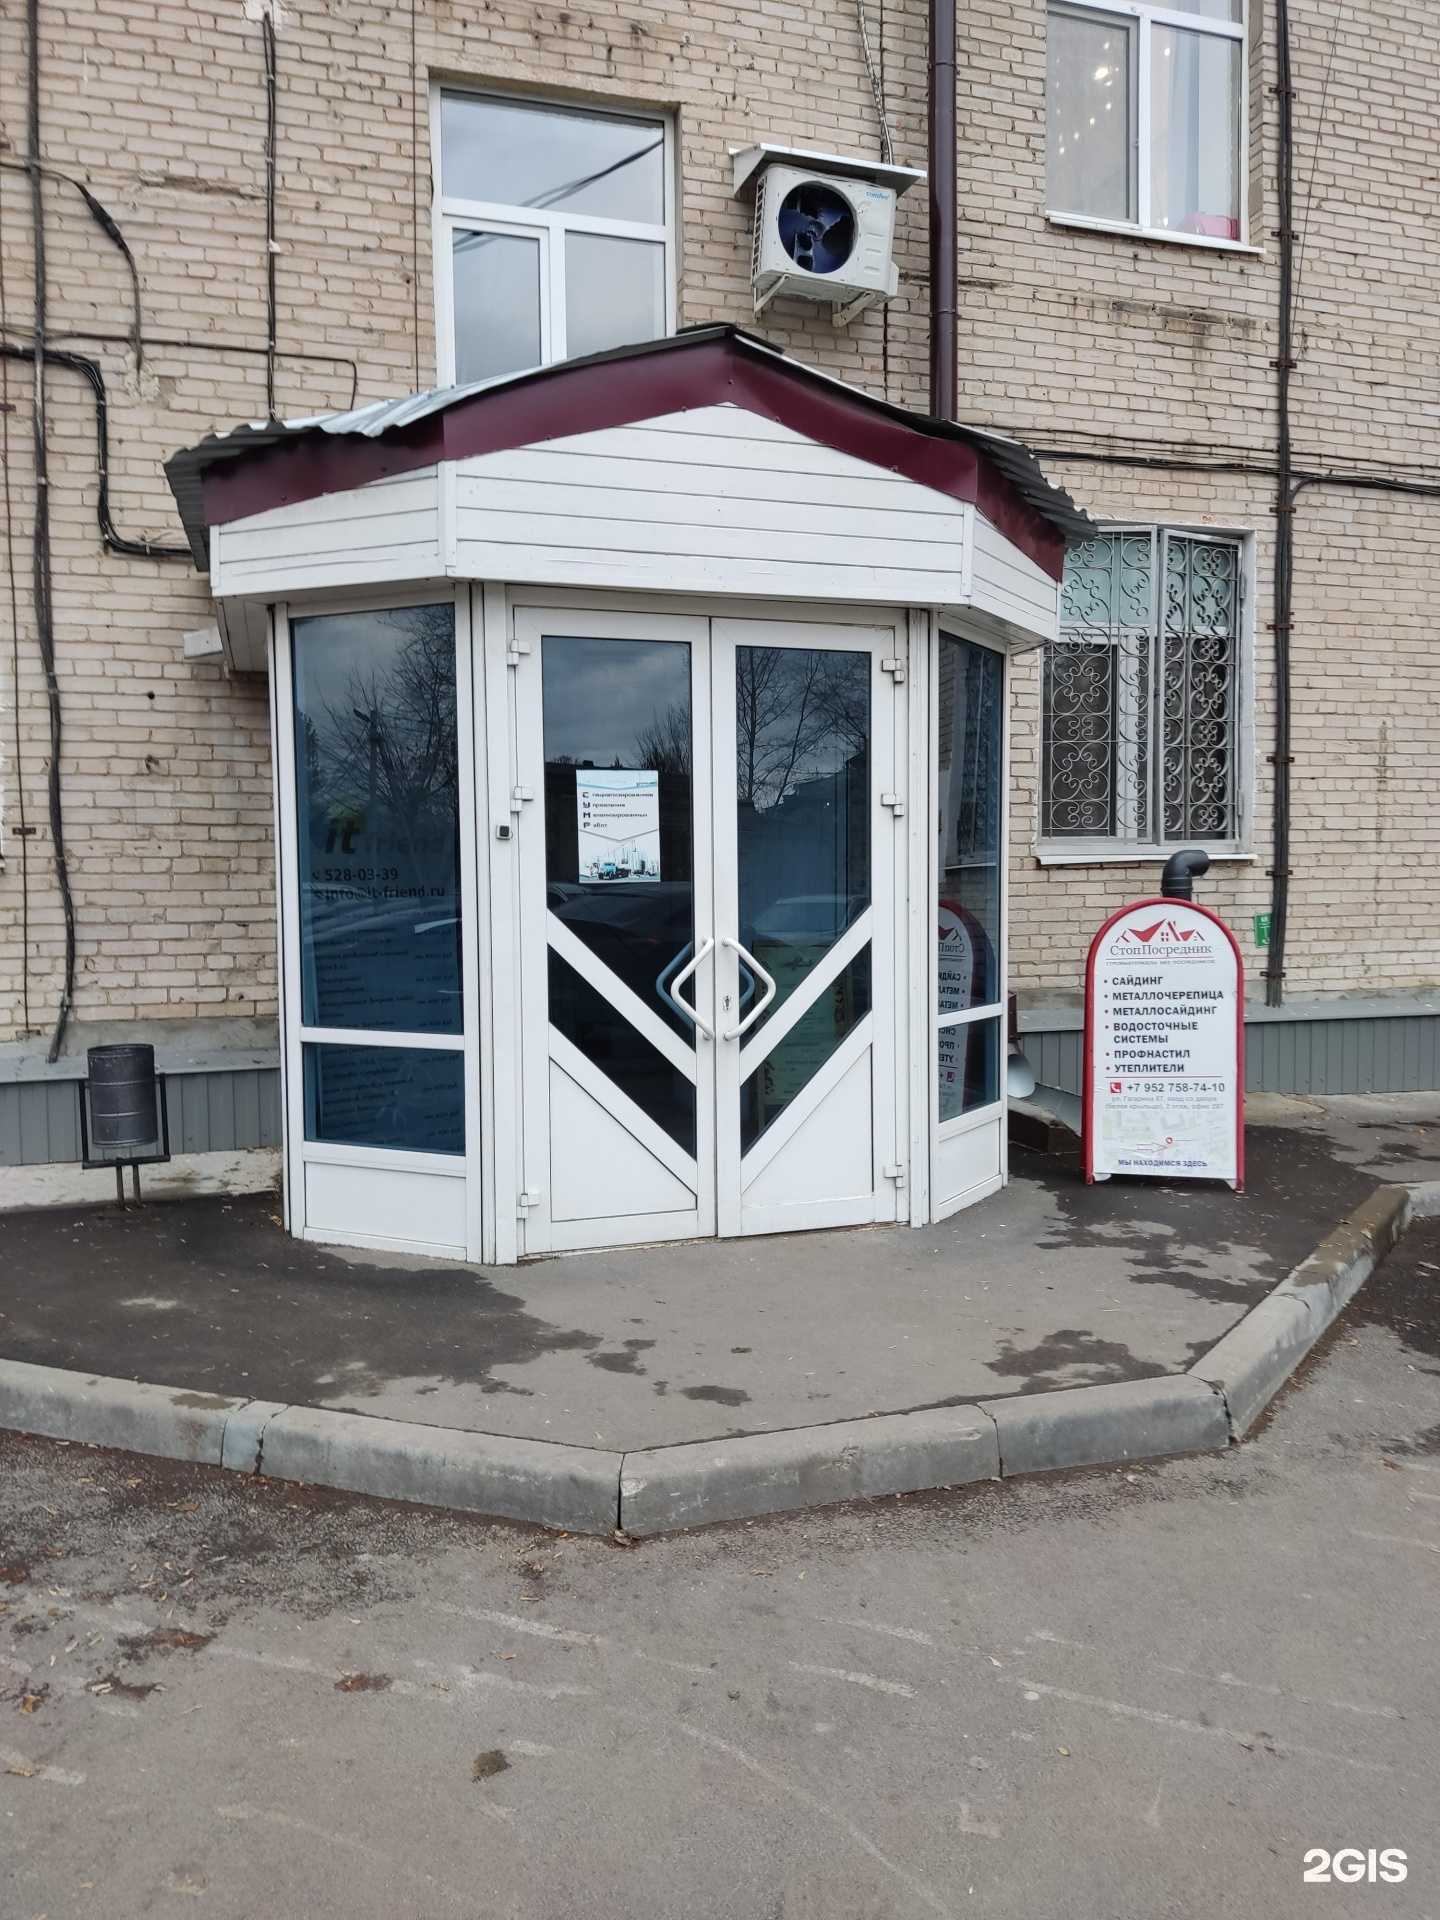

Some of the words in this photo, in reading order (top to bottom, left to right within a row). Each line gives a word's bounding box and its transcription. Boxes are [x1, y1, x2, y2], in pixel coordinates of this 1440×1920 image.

[325, 868, 399, 881] 528-03-39
[1110, 944, 1212, 957] СтопПосредник
[1112, 974, 1164, 986] САЙДИНГ
[1112, 990, 1224, 1001] МЕТАЛЛОЧЕРЕПИЦА
[1113, 1004, 1218, 1016] МЕТАЛЛОСАЙДИНГ
[1113, 1021, 1199, 1032] ВОДОСТОЧНЫЕ
[1113, 1035, 1169, 1044] СИСТЕМЫ
[1114, 1049, 1191, 1059] ПРОФНАСТИЛ
[1114, 1064, 1185, 1073] УТЕПЛИТЕЛИ
[1127, 1083, 1140, 1093] +7
[1144, 1083, 1165, 1093] 952
[1168, 1083, 1226, 1093] 758-74-10
